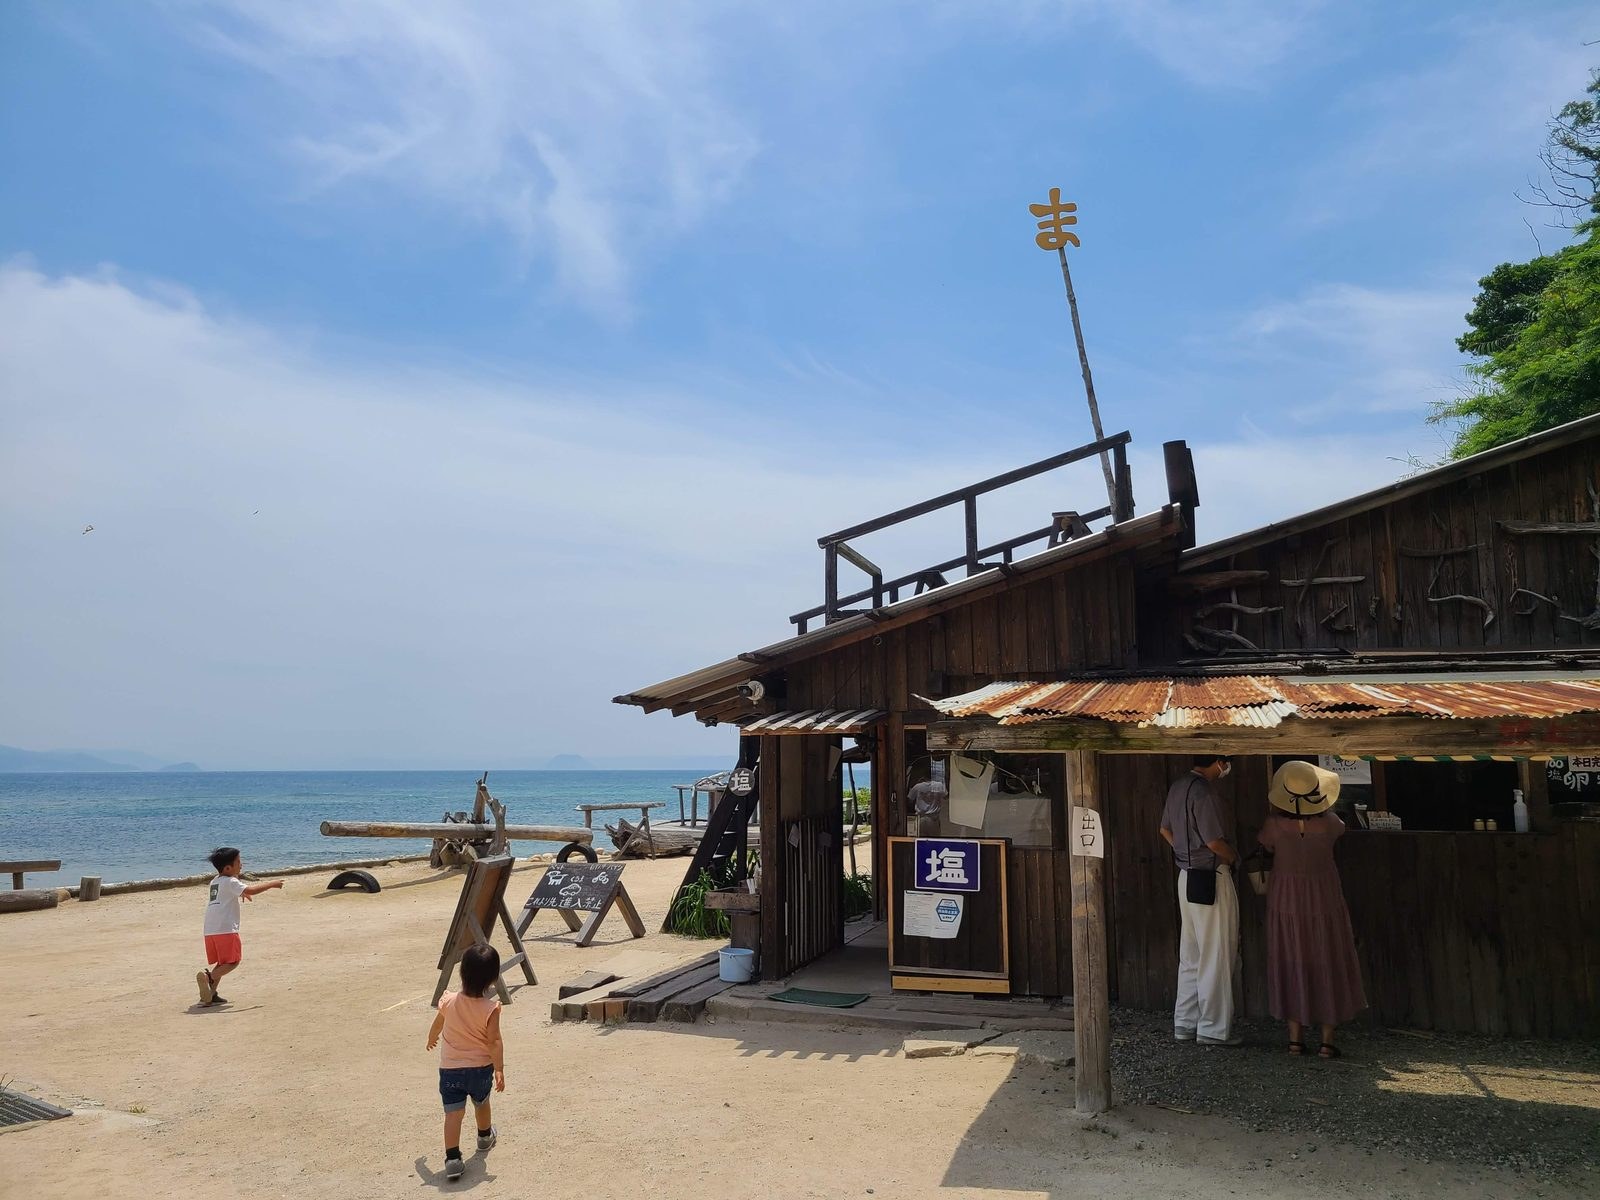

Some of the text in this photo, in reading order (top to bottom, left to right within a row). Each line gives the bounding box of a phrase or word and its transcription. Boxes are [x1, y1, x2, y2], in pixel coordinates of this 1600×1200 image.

[1029, 187, 1080, 250] ま
[731, 770, 751, 792] 塩
[1080, 815, 1095, 847] 出口
[925, 847, 969, 884] 塩
